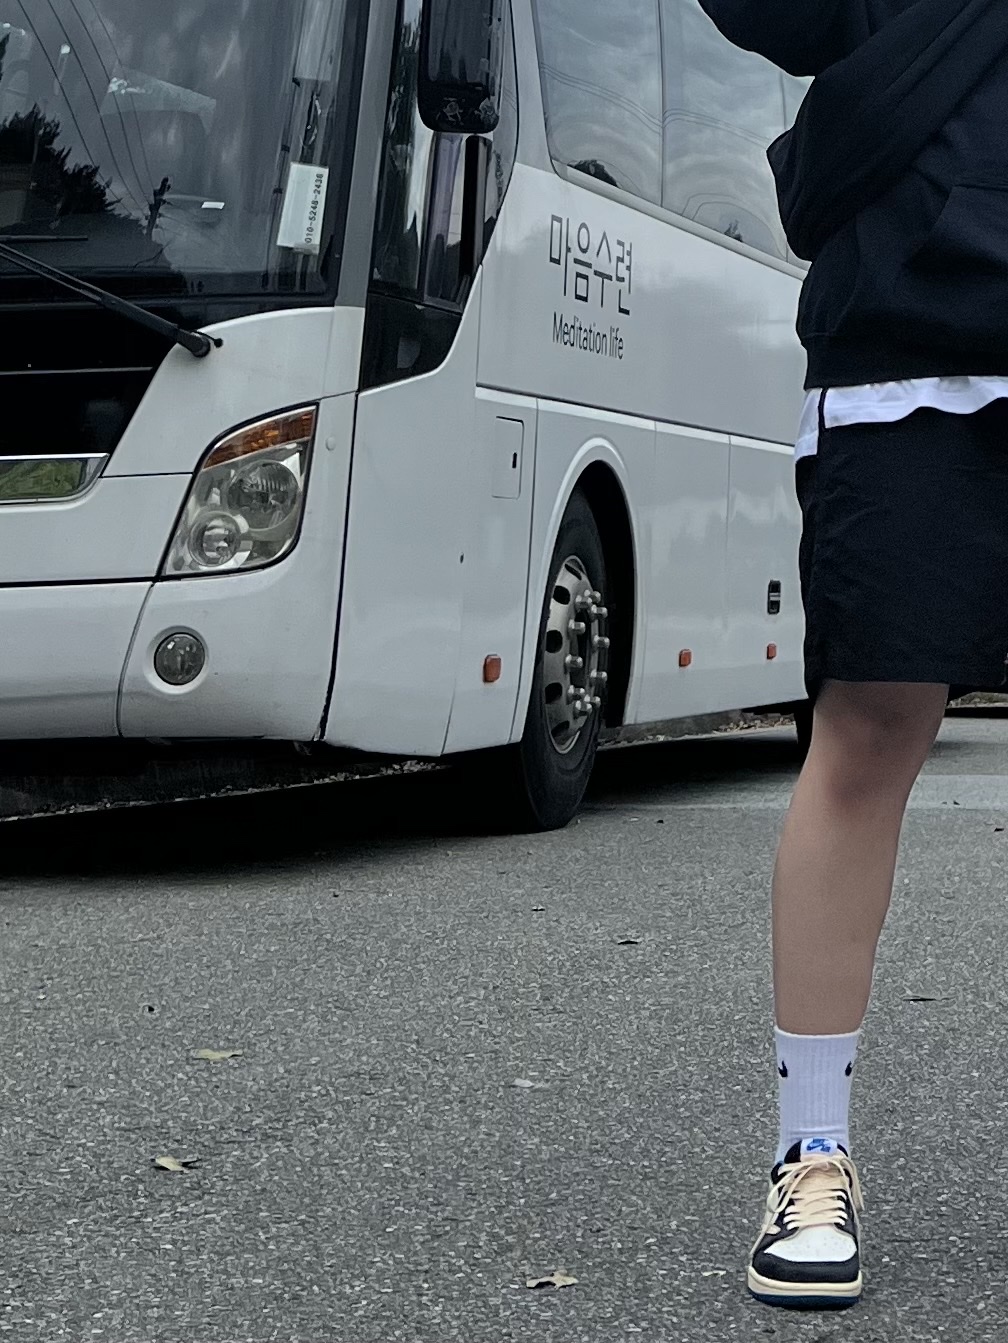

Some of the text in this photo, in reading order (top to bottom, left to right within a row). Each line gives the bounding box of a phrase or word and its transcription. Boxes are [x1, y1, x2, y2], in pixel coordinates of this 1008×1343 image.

[549, 214, 633, 316] 마음수련
[552, 311, 624, 359] Meditation life
